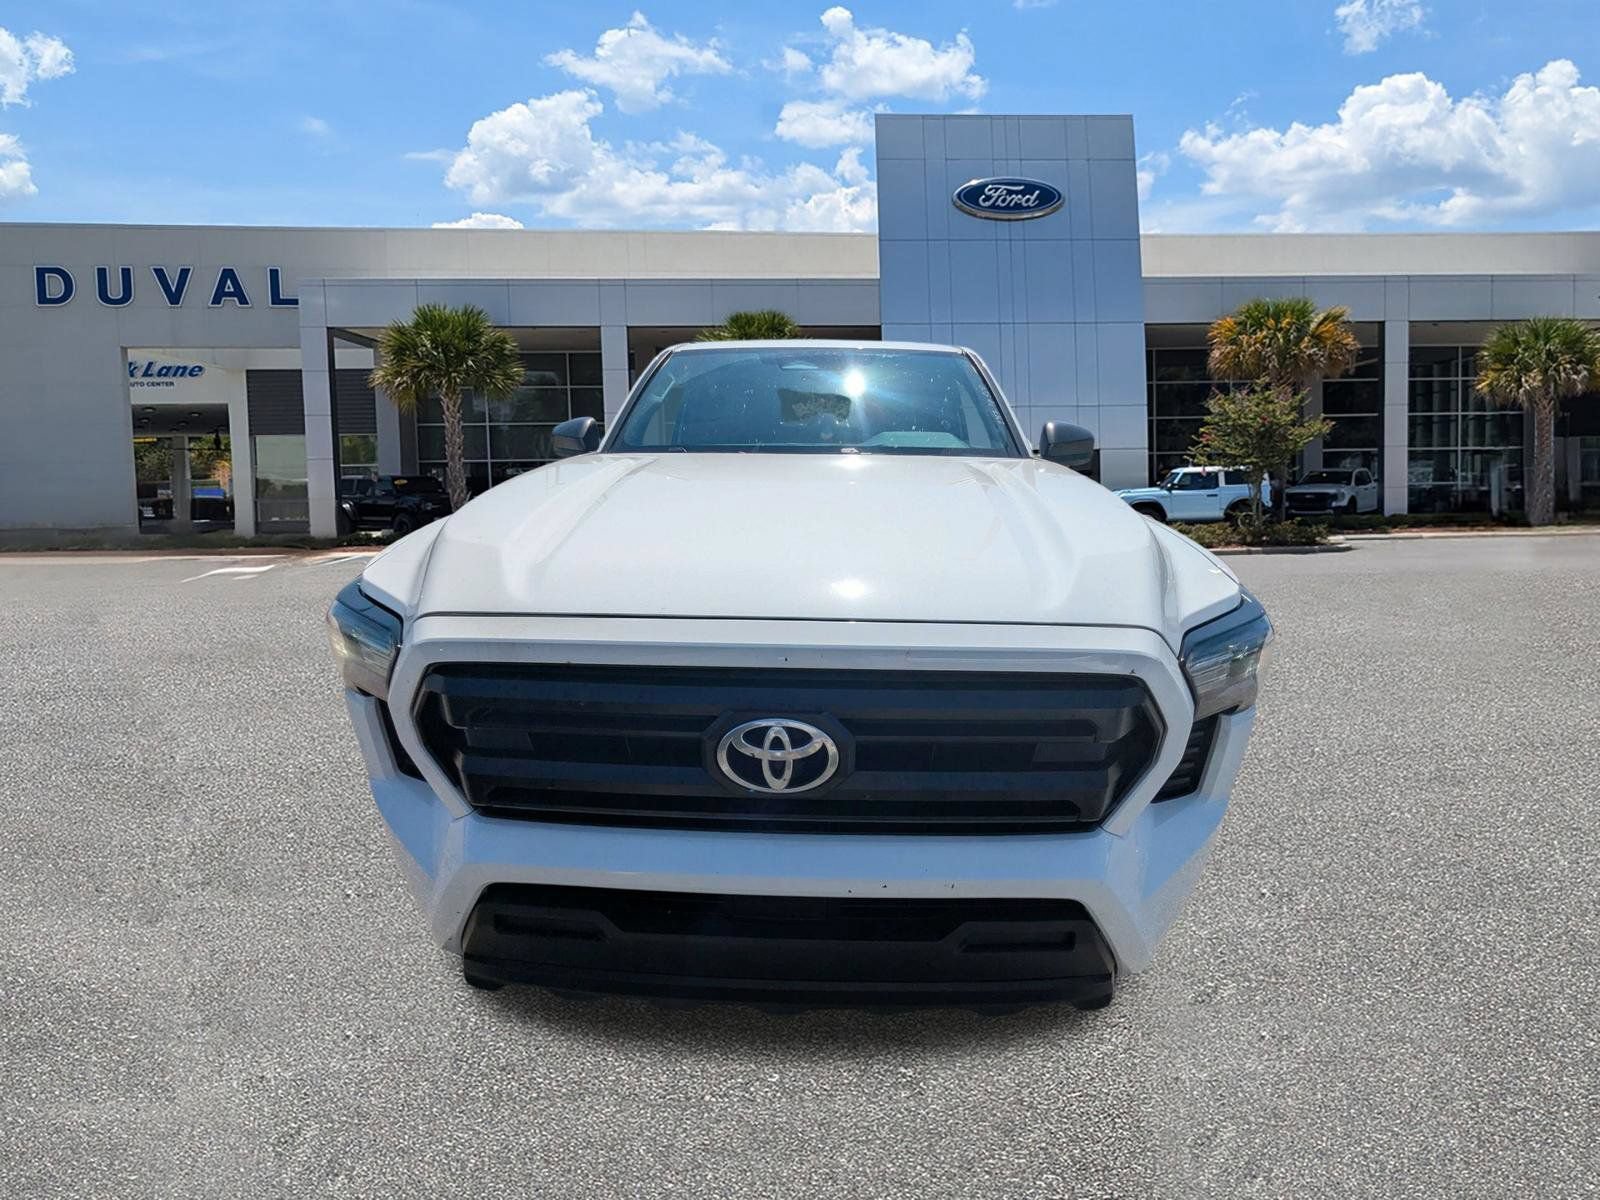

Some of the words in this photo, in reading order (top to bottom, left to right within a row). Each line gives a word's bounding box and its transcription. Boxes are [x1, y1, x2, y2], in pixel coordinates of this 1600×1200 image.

[978, 184, 1040, 207] Ford
[34, 265, 299, 307] DUVAL
[141, 361, 205, 378] Lane
